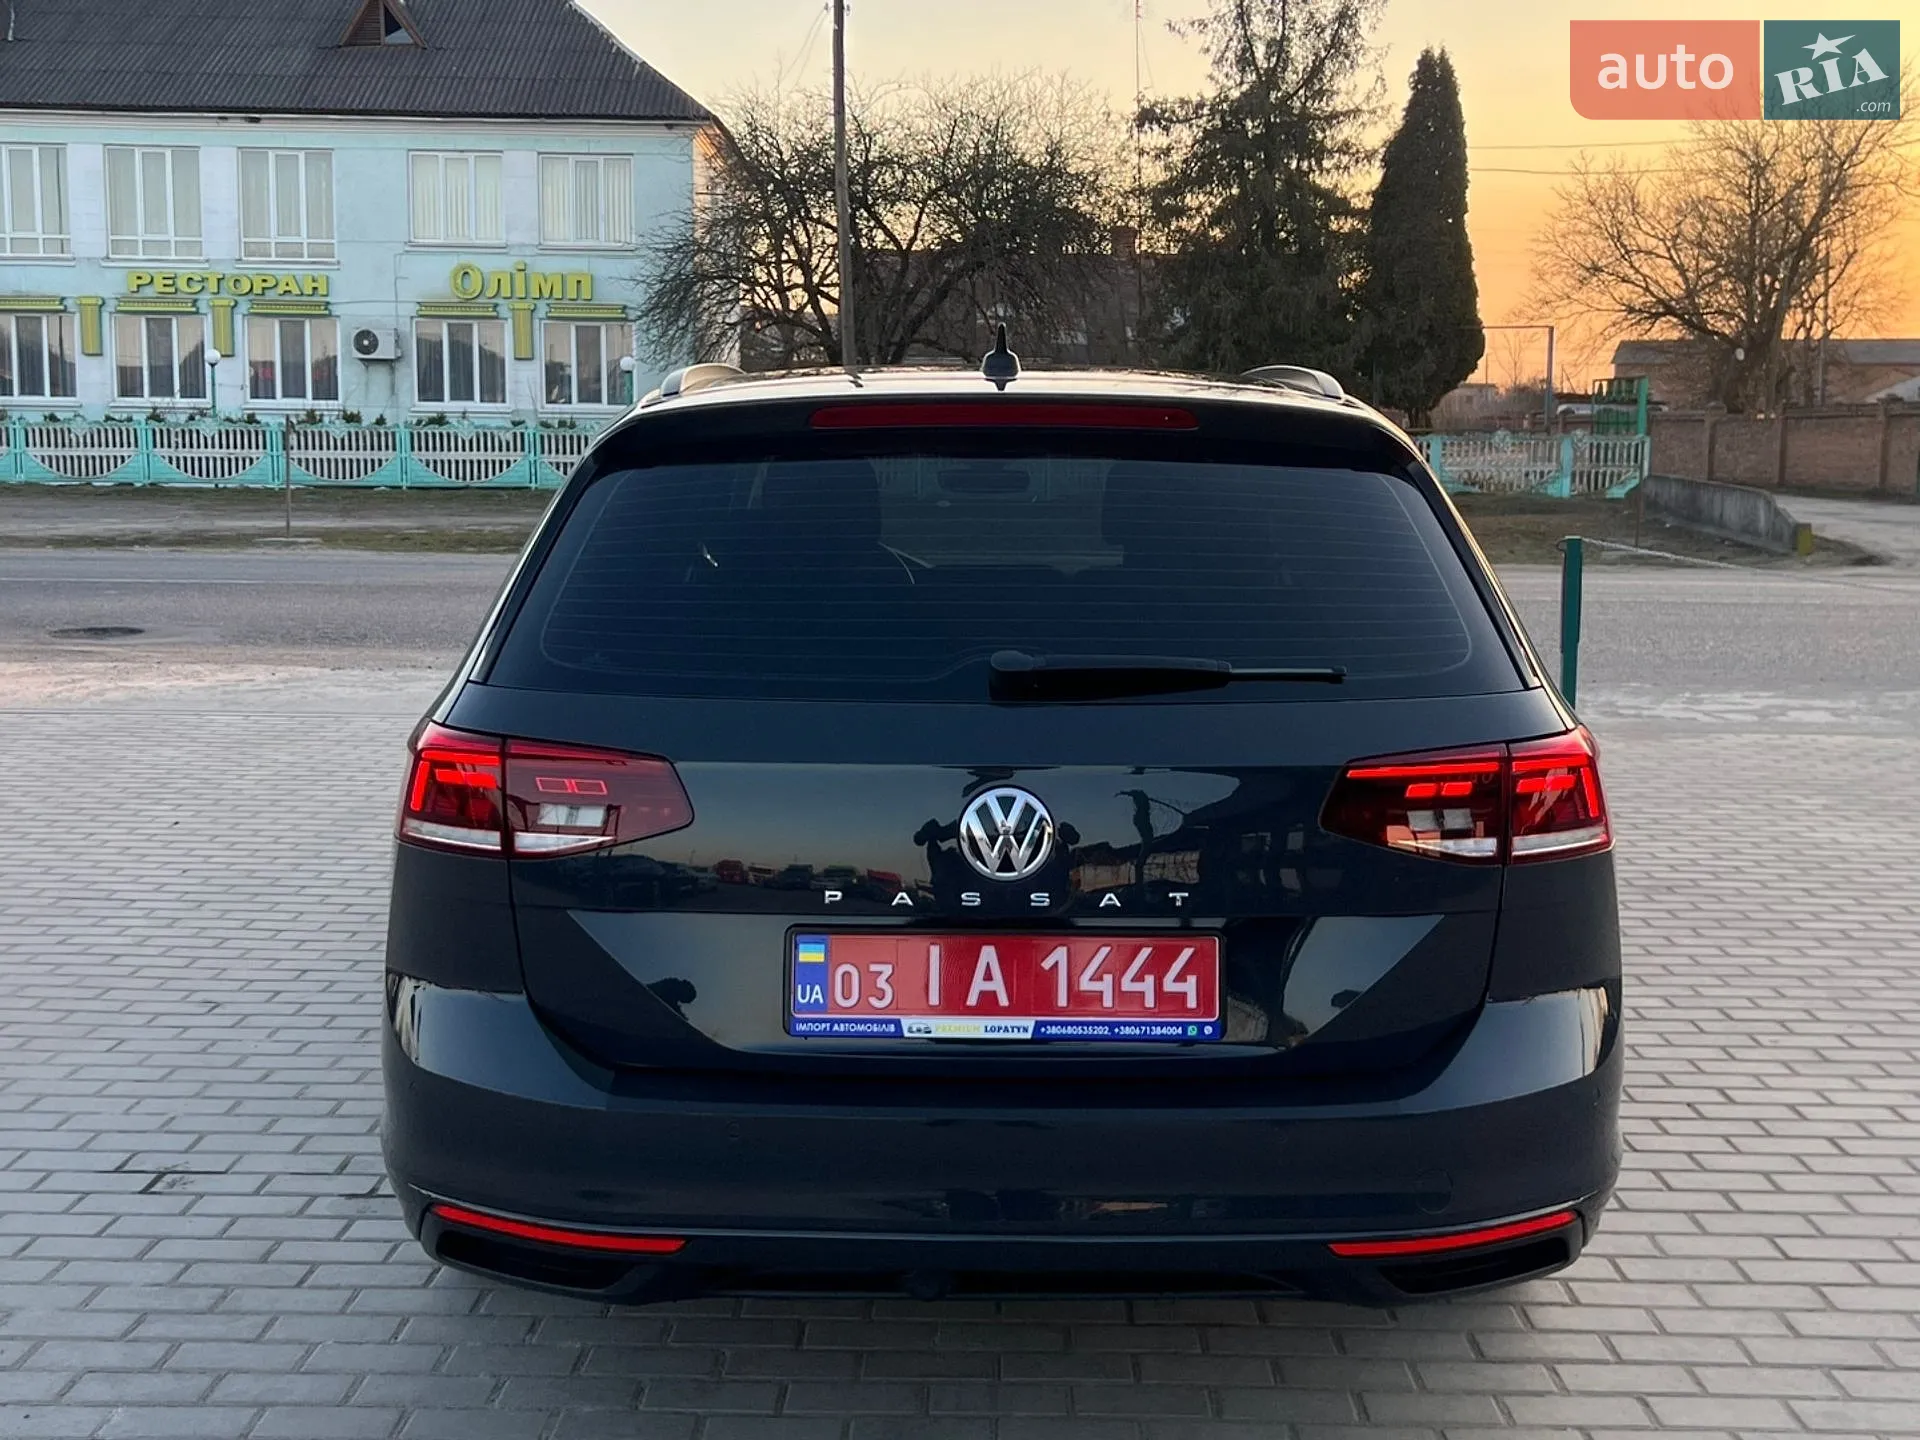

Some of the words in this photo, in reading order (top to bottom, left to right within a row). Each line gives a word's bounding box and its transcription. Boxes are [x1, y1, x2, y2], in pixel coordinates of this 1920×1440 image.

[127, 271, 330, 297] РЕСТОРАН
[451, 260, 594, 300] Олімп
[824, 890, 1190, 908] PASSAT
[833, 962, 895, 1010] 03
[928, 943, 1010, 1007] IA
[1040, 945, 1198, 1010] 1444
[796, 983, 825, 1005] UA
[795, 1022, 830, 1033] ІМПОРТ
[984, 1024, 1030, 1035] LOPATYN
